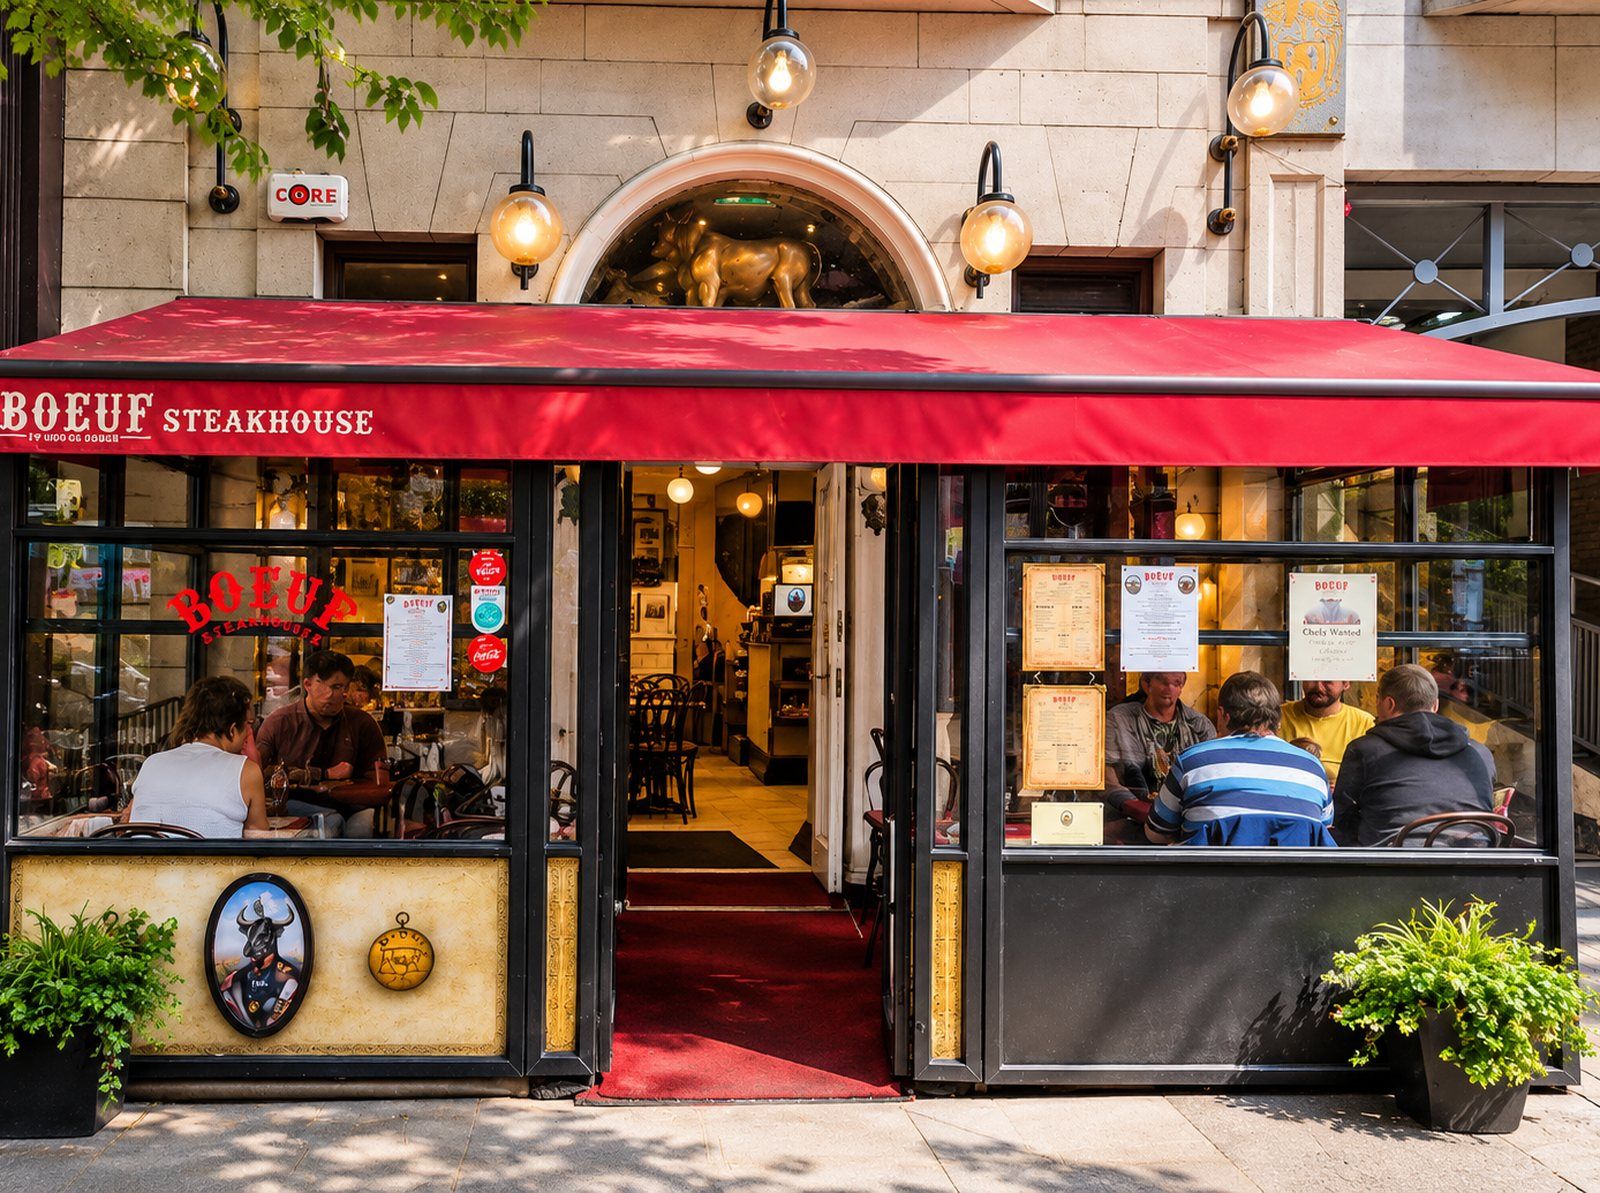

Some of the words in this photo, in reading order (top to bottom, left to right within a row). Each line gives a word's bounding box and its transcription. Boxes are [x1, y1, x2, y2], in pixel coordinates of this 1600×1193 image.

[275, 184, 337, 206] CORE
[0, 391, 154, 433] BOEUF
[163, 408, 374, 435] STEAKHOUSE
